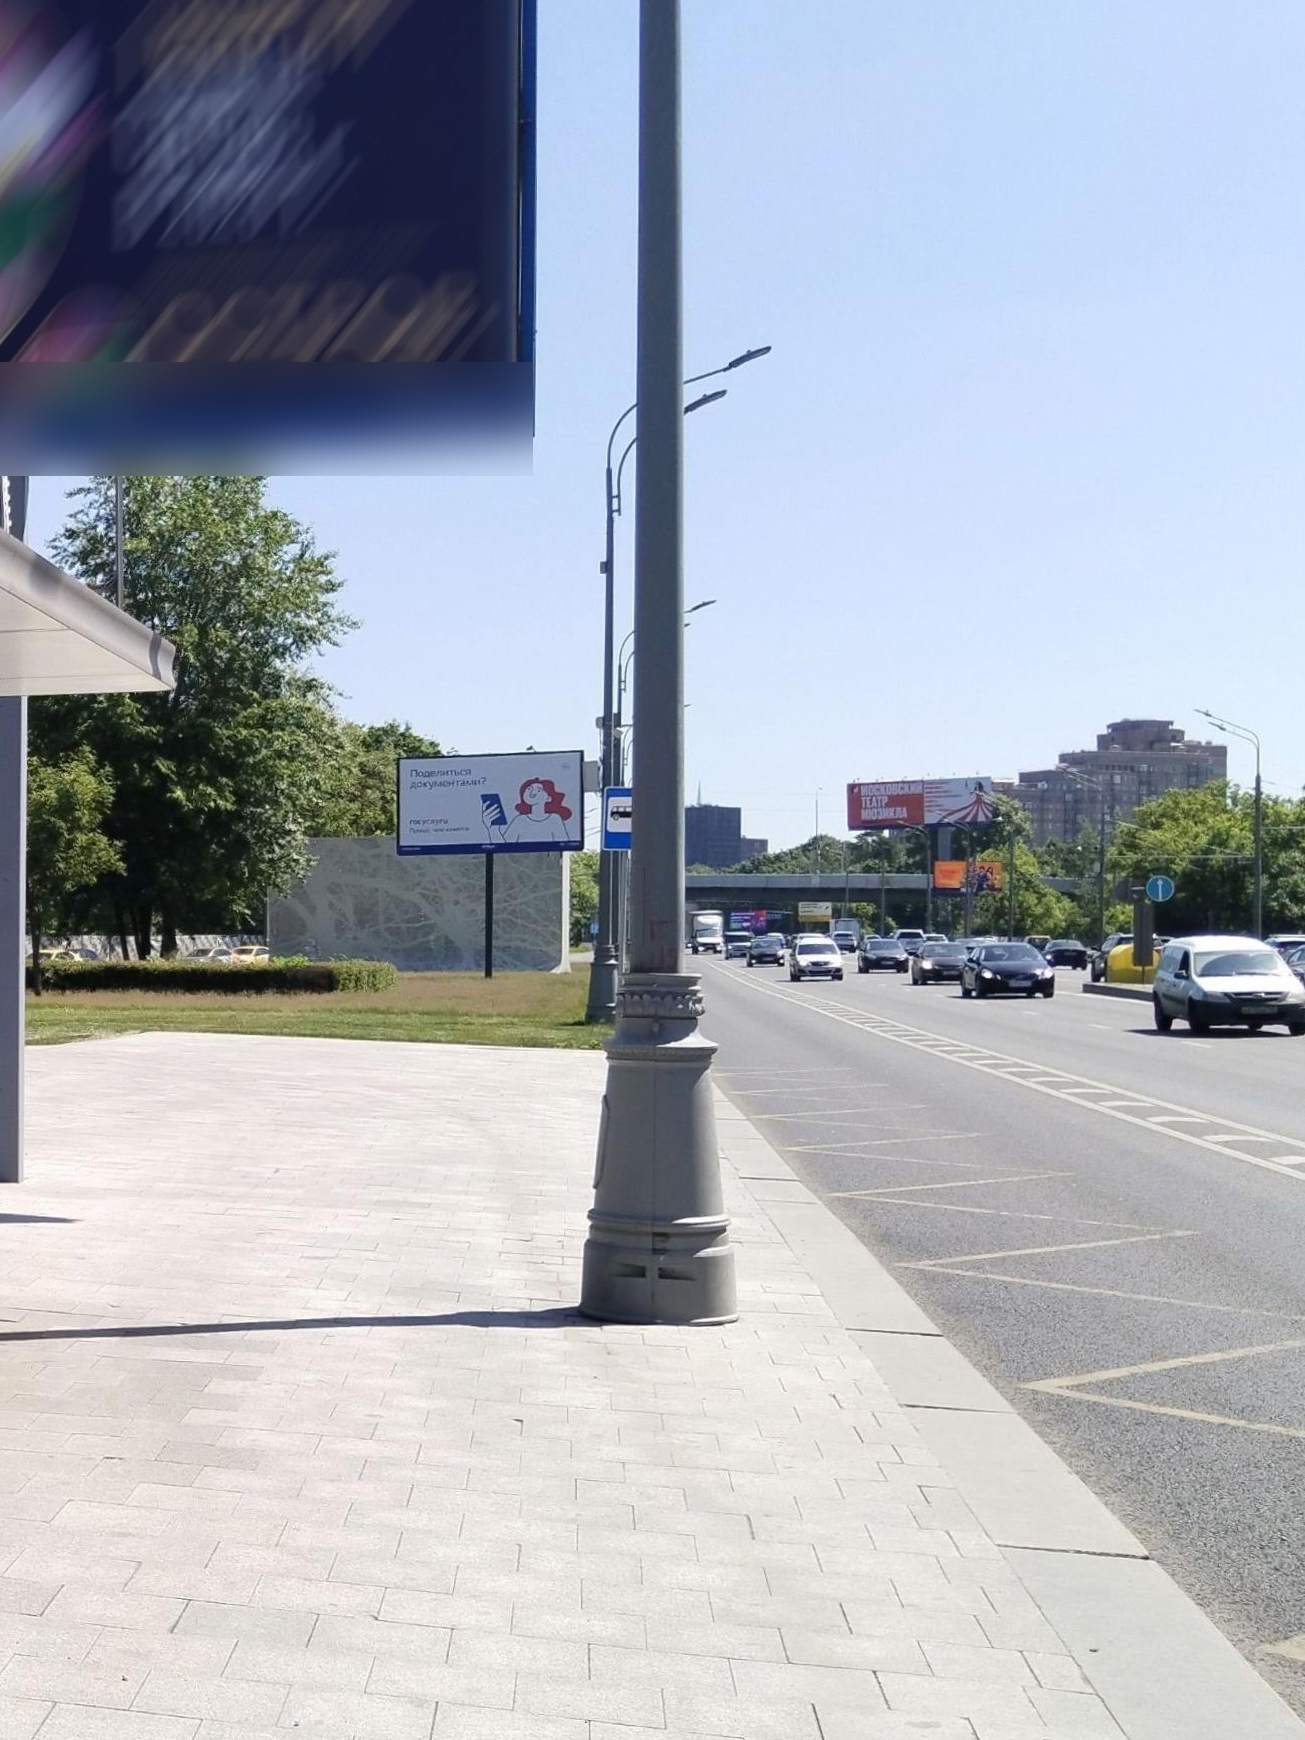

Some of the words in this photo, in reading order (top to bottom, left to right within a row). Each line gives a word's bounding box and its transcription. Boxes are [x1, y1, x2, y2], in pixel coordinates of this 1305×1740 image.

[409, 769, 472, 779] Поделиться
[409, 776, 487, 791] документами?
[861, 795, 889, 809] ТЕАТР
